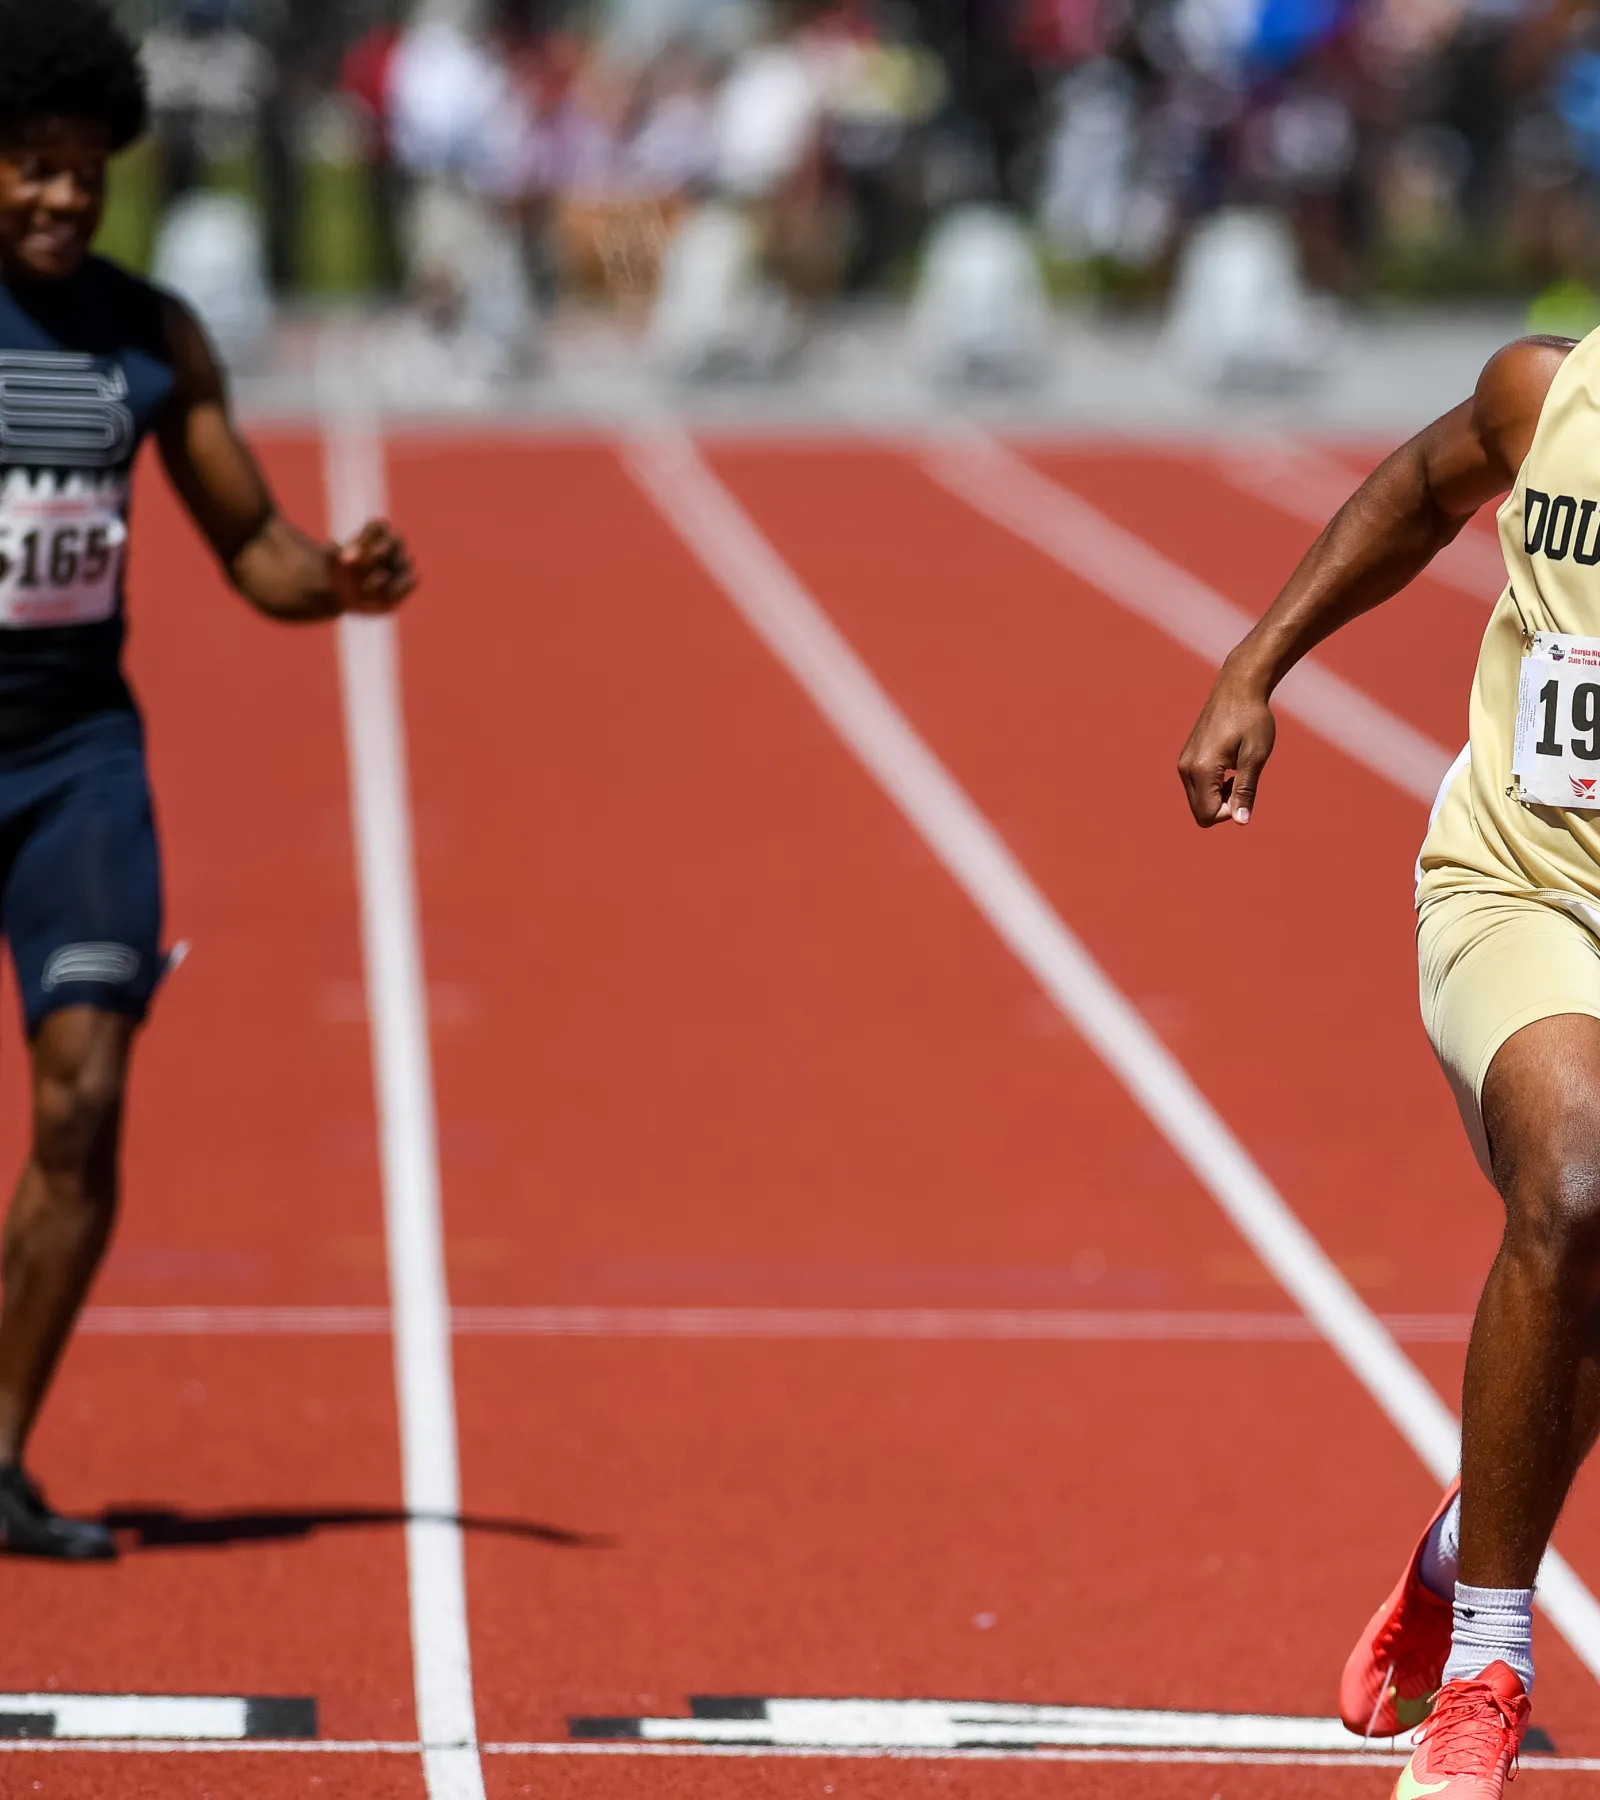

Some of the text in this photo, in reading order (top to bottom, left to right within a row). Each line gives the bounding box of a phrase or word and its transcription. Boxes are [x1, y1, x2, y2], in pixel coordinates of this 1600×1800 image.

[1571, 647, 1591, 656] Georgia
[1568, 656, 1581, 665] State
[1582, 658, 1597, 666] Track
